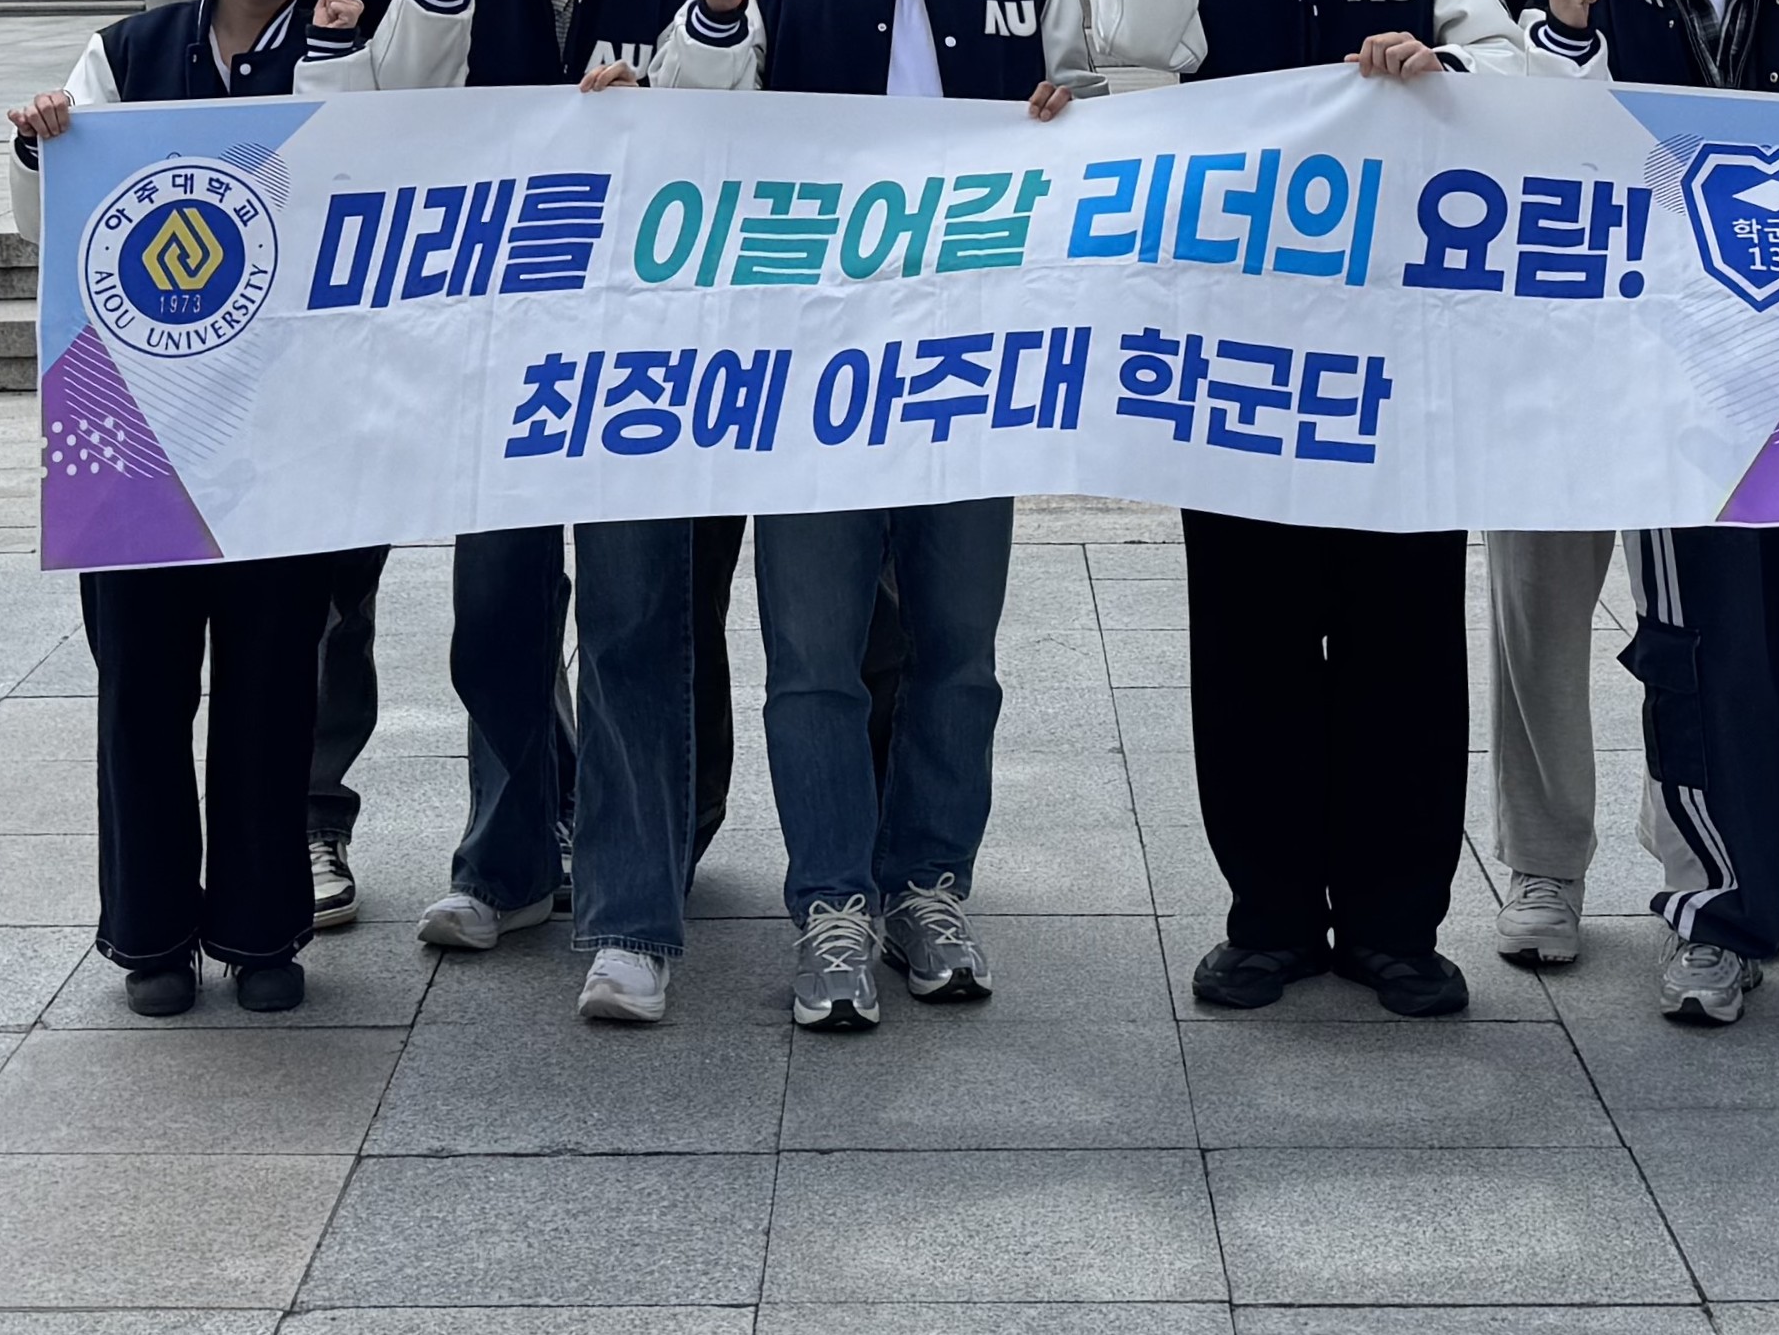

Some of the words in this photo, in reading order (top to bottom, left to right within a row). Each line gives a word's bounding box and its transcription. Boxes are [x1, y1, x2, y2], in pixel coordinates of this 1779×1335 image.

[984, 0, 1037, 37] AU
[584, 39, 654, 81] AU
[105, 172, 260, 231] 아주대학교
[306, 172, 612, 311] 미래를
[633, 168, 1052, 288] 이끌어갈
[1067, 148, 1383, 287] 리더의
[1402, 168, 1653, 300] 요람!
[94, 269, 137, 331] AJOU
[145, 262, 270, 352] UNIVERSITY
[158, 293, 203, 316] 1973
[503, 348, 793, 459] 최정예
[812, 326, 1092, 447] 아주대
[1115, 326, 1393, 465] 학군단
